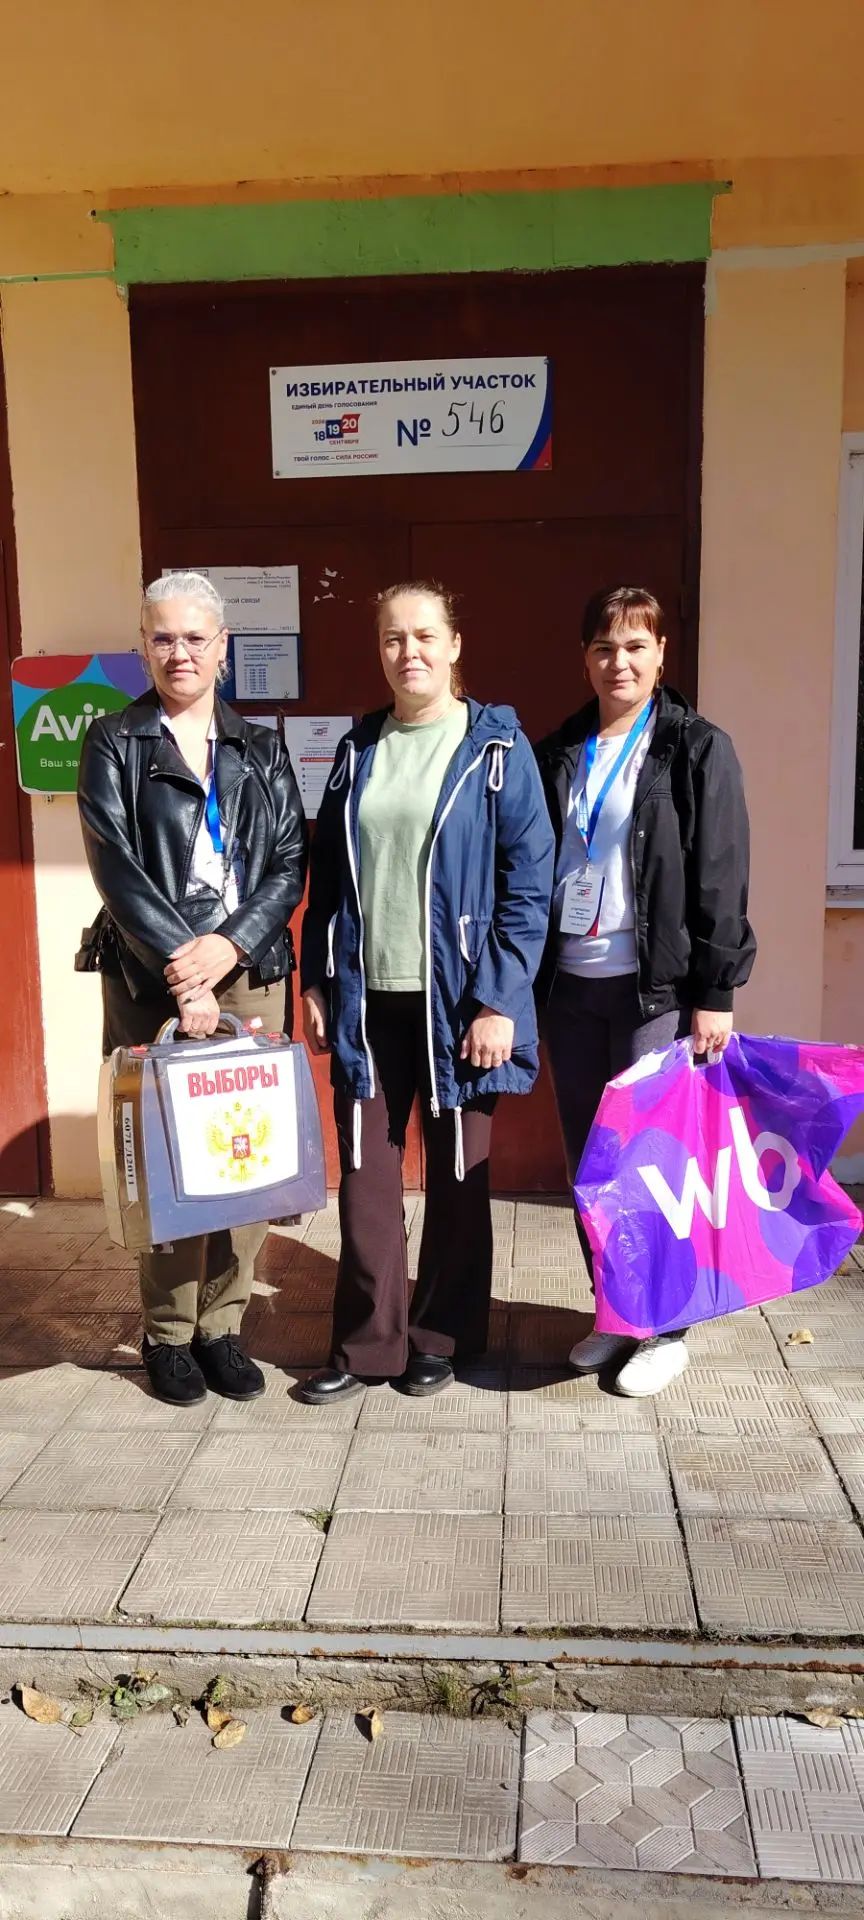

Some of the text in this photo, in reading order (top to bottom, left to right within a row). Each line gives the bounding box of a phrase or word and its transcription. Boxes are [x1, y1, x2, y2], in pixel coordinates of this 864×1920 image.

[286, 373, 536, 397] ИЗБИРАТЕЛЬНЫЙ УЧАСТОК
[313, 419, 357, 441] 18 19 20
[441, 400, 506, 437] 546
[397, 418, 431, 447] №
[40, 758, 63, 767] Ваш
[187, 1063, 280, 1098] ВЫБОРЫ
